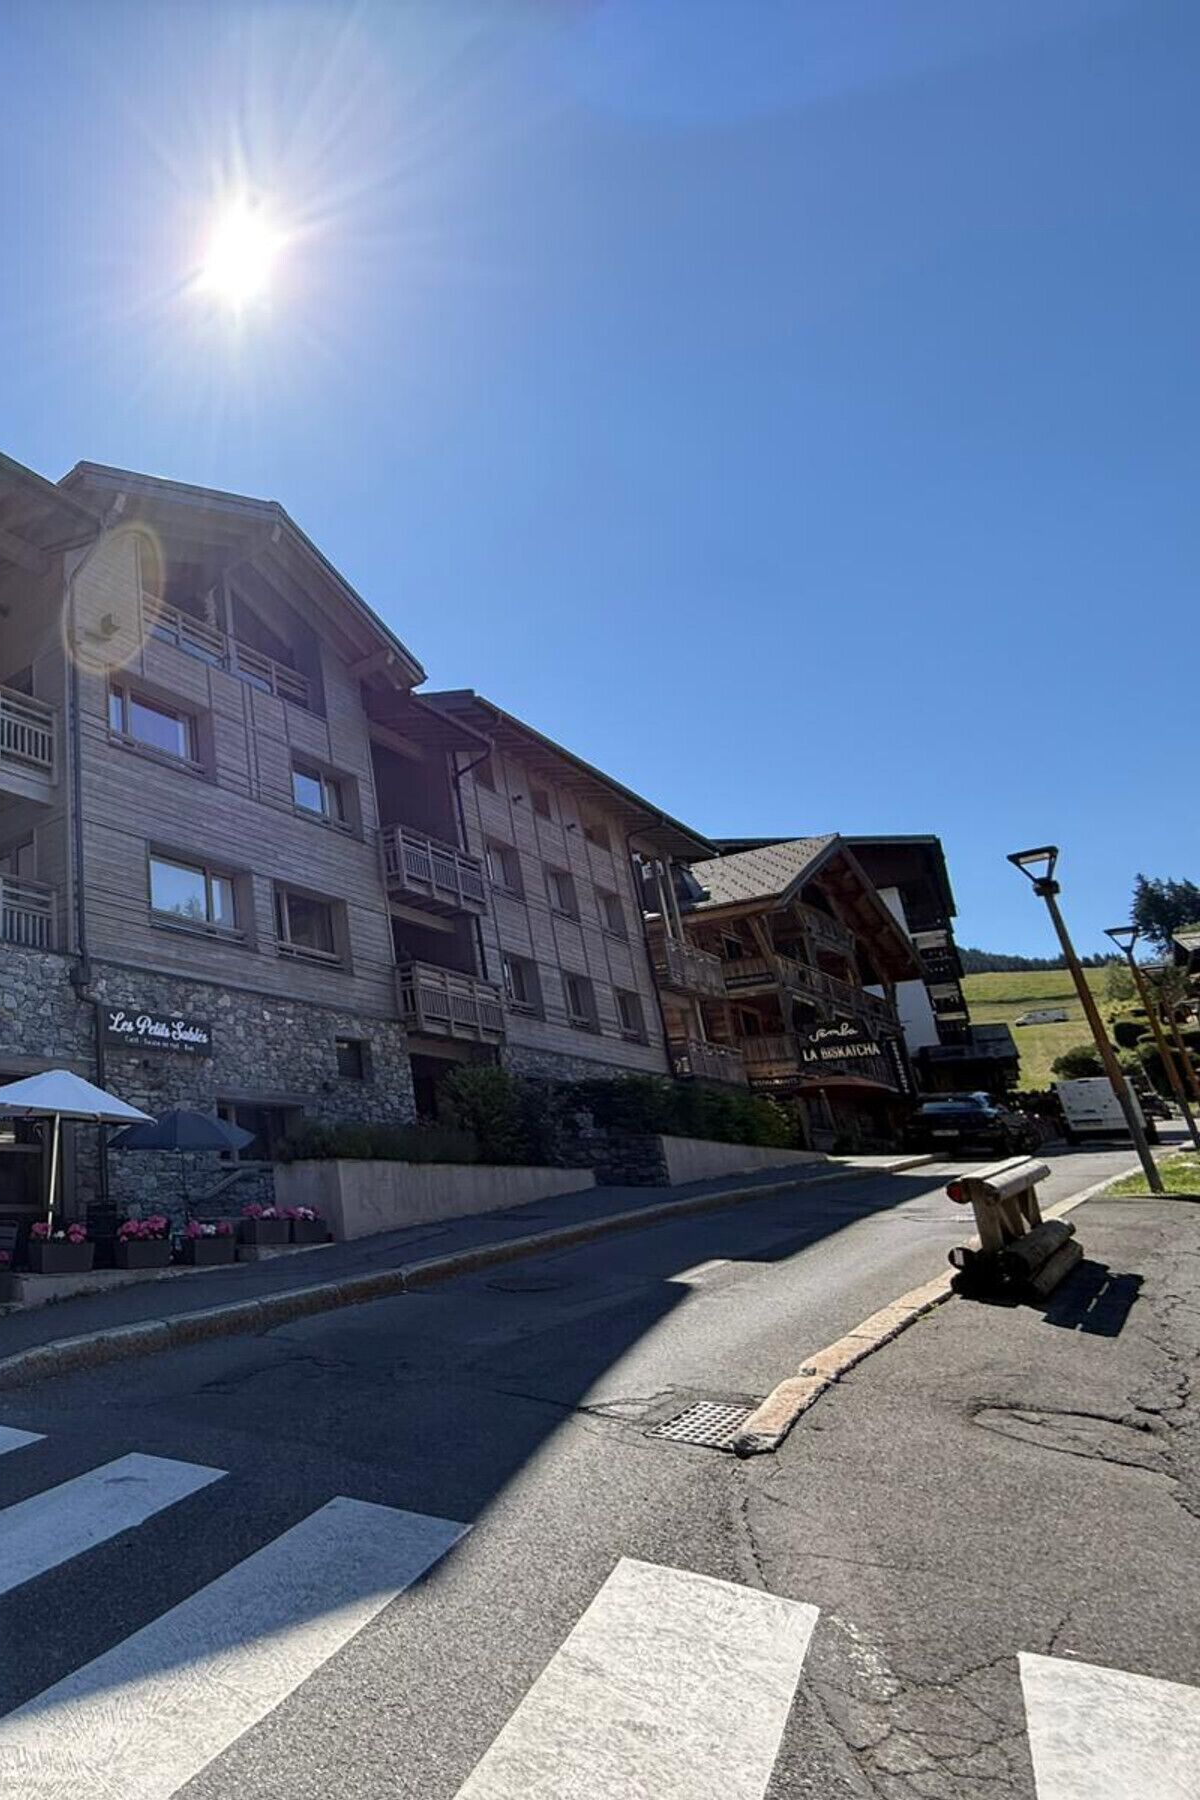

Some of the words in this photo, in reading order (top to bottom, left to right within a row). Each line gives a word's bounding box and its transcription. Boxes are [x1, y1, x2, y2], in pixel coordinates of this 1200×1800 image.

[108, 1011, 135, 1033] Les
[136, 1015, 170, 1037] Petits
[802, 1048, 819, 1061] LA
